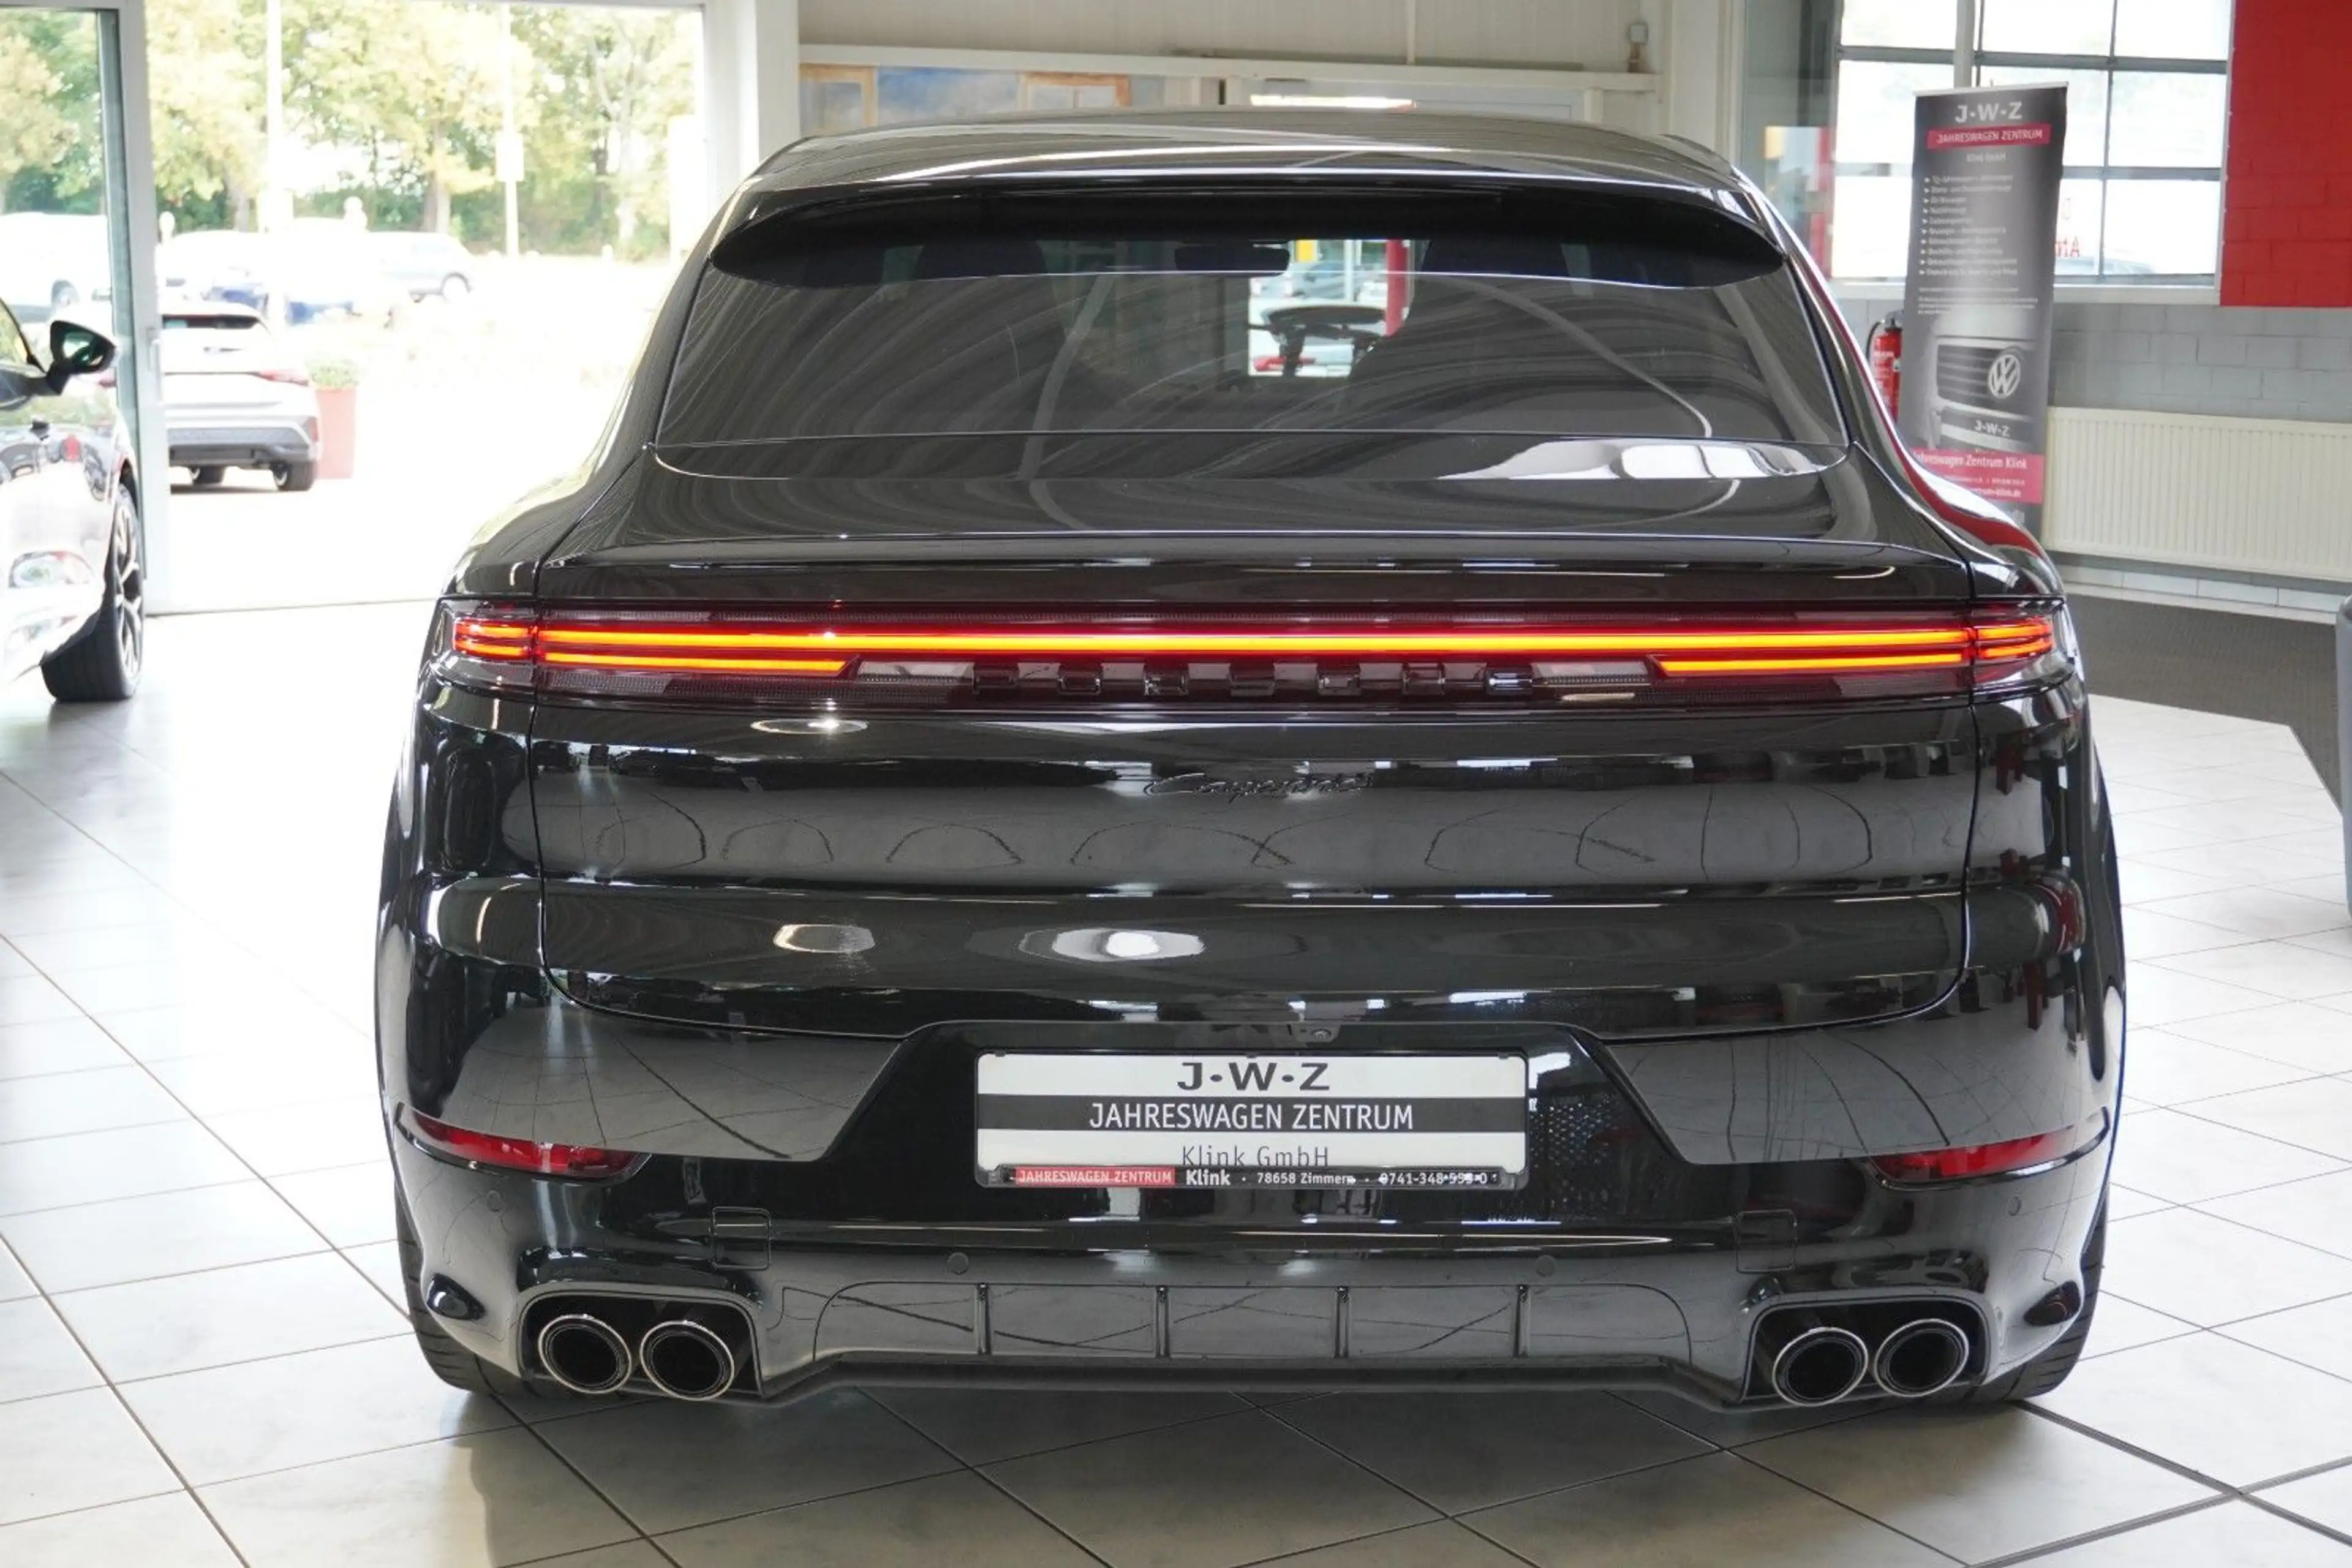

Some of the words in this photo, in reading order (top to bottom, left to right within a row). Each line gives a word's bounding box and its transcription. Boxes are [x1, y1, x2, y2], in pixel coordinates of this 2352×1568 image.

[1936, 131, 1999, 144] JAHRESWAGEN
[2001, 129, 2044, 141] ZENTRUM
[1966, 454, 2004, 469] Zentrum
[2006, 456, 2027, 469] Klink
[1090, 1102, 1283, 1130] JAHRESWAGEN
[1292, 1104, 1413, 1130] ZENTRUM
[1182, 1144, 1245, 1166] Klink
[1257, 1145, 1329, 1167] GmbH
[1019, 1170, 1110, 1183] JAHRESWAGEN
[1114, 1170, 1172, 1183] ZENTRUM
[1186, 1169, 1231, 1185] Klink
[1257, 1172, 1296, 1185] 78658
